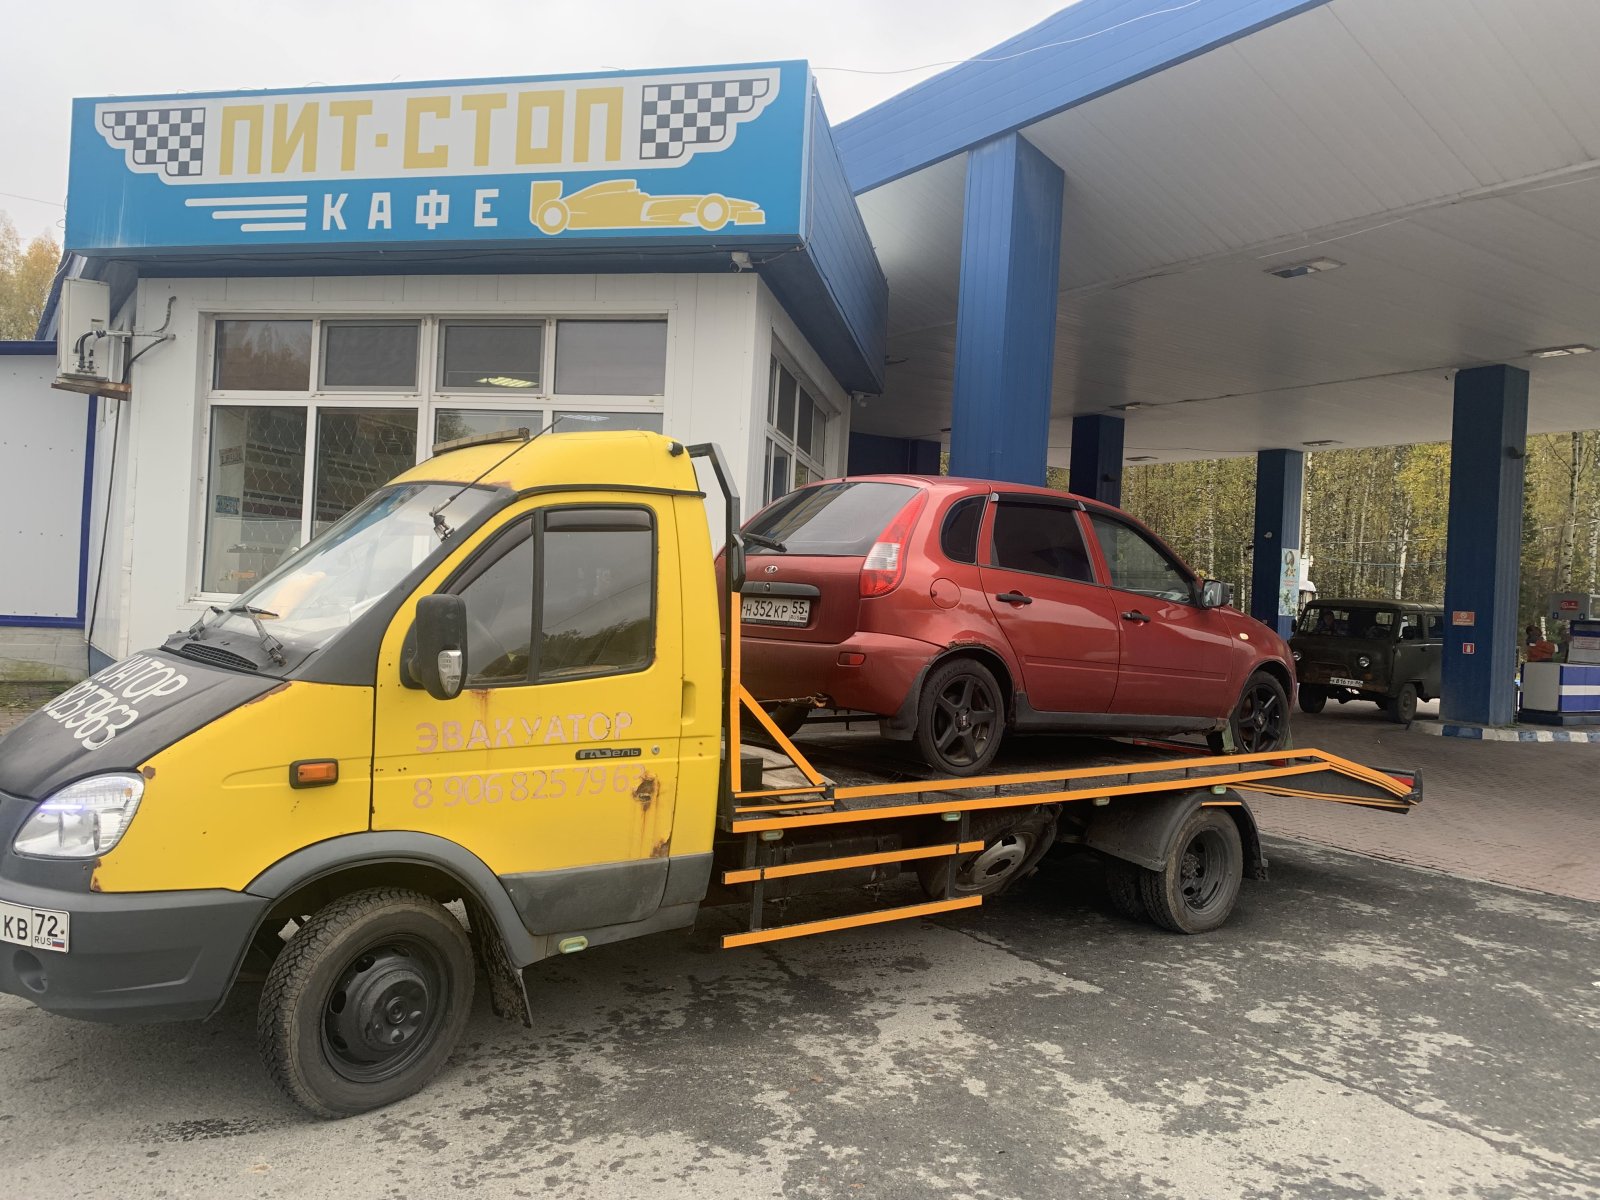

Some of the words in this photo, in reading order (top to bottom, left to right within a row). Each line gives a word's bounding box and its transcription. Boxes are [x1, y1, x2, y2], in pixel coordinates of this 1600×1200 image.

[322, 188, 500, 231] КАФЕ
[792, 601, 805, 615] 55
[416, 711, 633, 752] ЭВАКУАТОР
[412, 777, 433, 809] 8
[443, 772, 504, 807] 906
[510, 769, 568, 802] 825
[3, 914, 28, 941] КВ
[35, 913, 58, 938] 72
[34, 935, 52, 946] RUS
